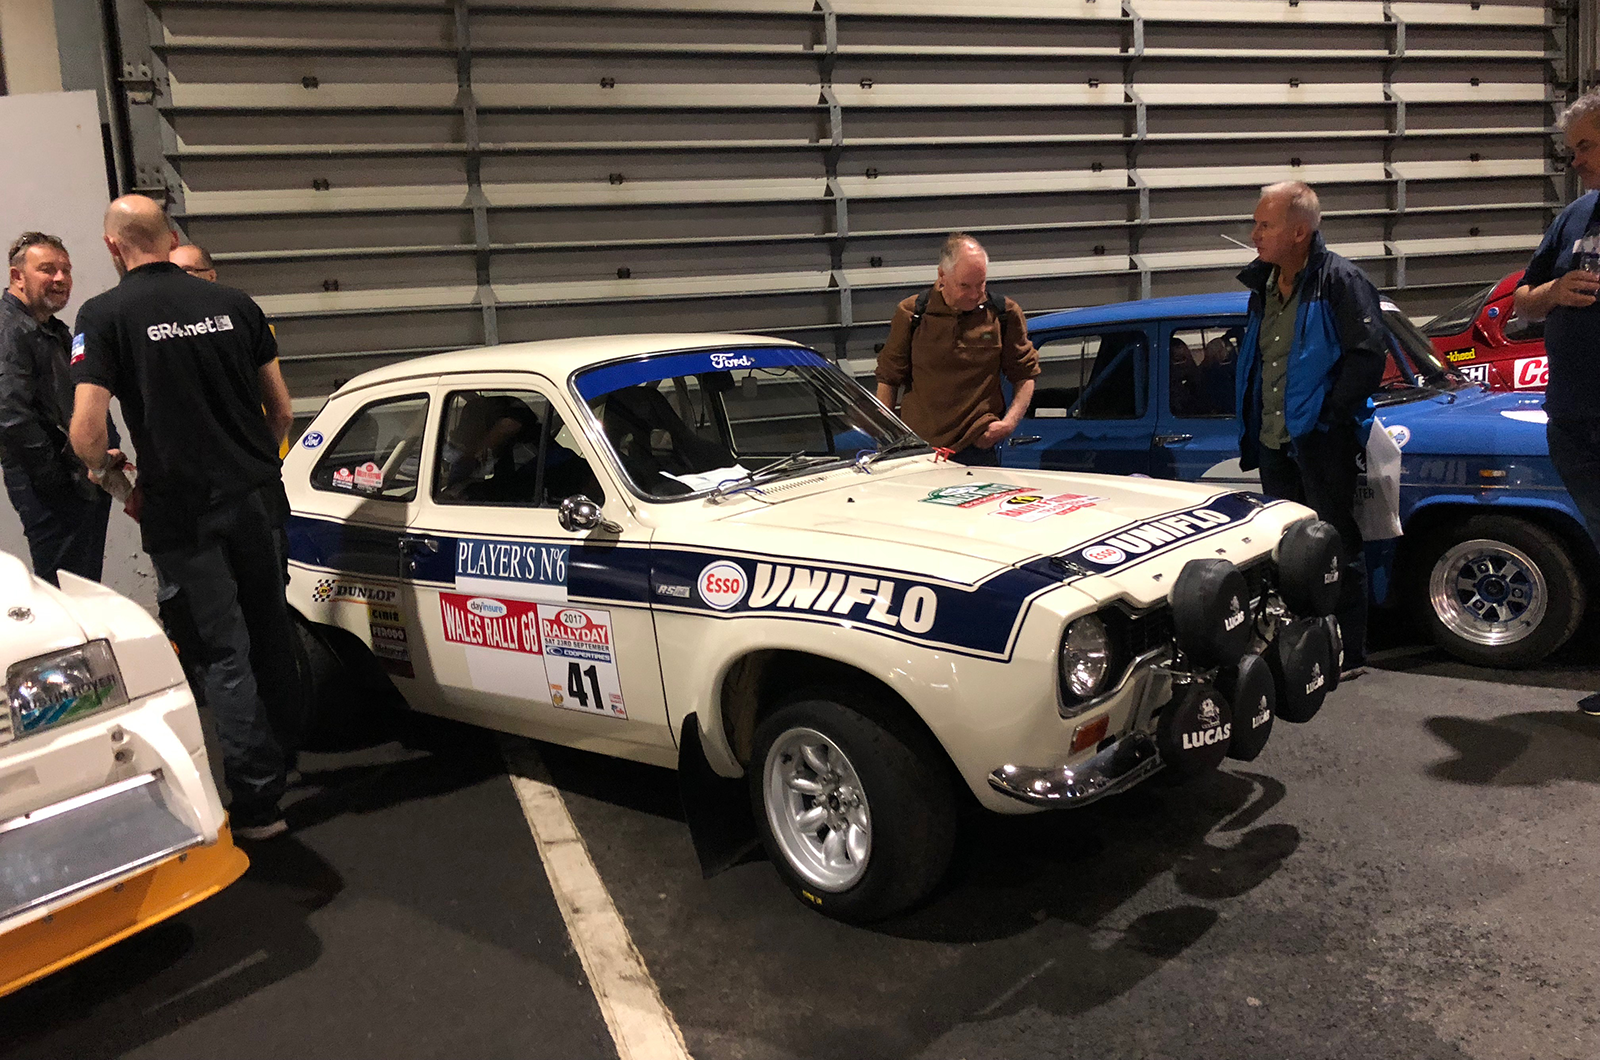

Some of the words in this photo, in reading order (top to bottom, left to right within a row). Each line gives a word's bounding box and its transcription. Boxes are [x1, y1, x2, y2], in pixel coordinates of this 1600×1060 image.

[147, 317, 216, 341] 6R4.net
[710, 353, 751, 368] Ford
[1446, 348, 1476, 362] kheed
[1104, 509, 1231, 554] UNIFLO
[457, 542, 535, 580] PLAYER'S
[335, 585, 396, 602] DUNLOP
[748, 562, 938, 634] UNIFLO
[470, 602, 504, 615] dayinsure
[564, 613, 582, 624] 2017
[442, 600, 484, 645] WALES
[484, 616, 519, 650] RALLY
[521, 611, 539, 653] GB
[1225, 610, 1245, 631] LUCAS
[543, 620, 607, 644] RALLYDAY
[545, 638, 555, 646] SAT
[557, 640, 572, 648] 23RD
[573, 641, 610, 652] SEPTEMBER
[568, 662, 604, 710] 41
[1306, 675, 1325, 695] LUCAS
[1252, 709, 1271, 729] LUCAS
[1182, 723, 1232, 750] LUCAS
